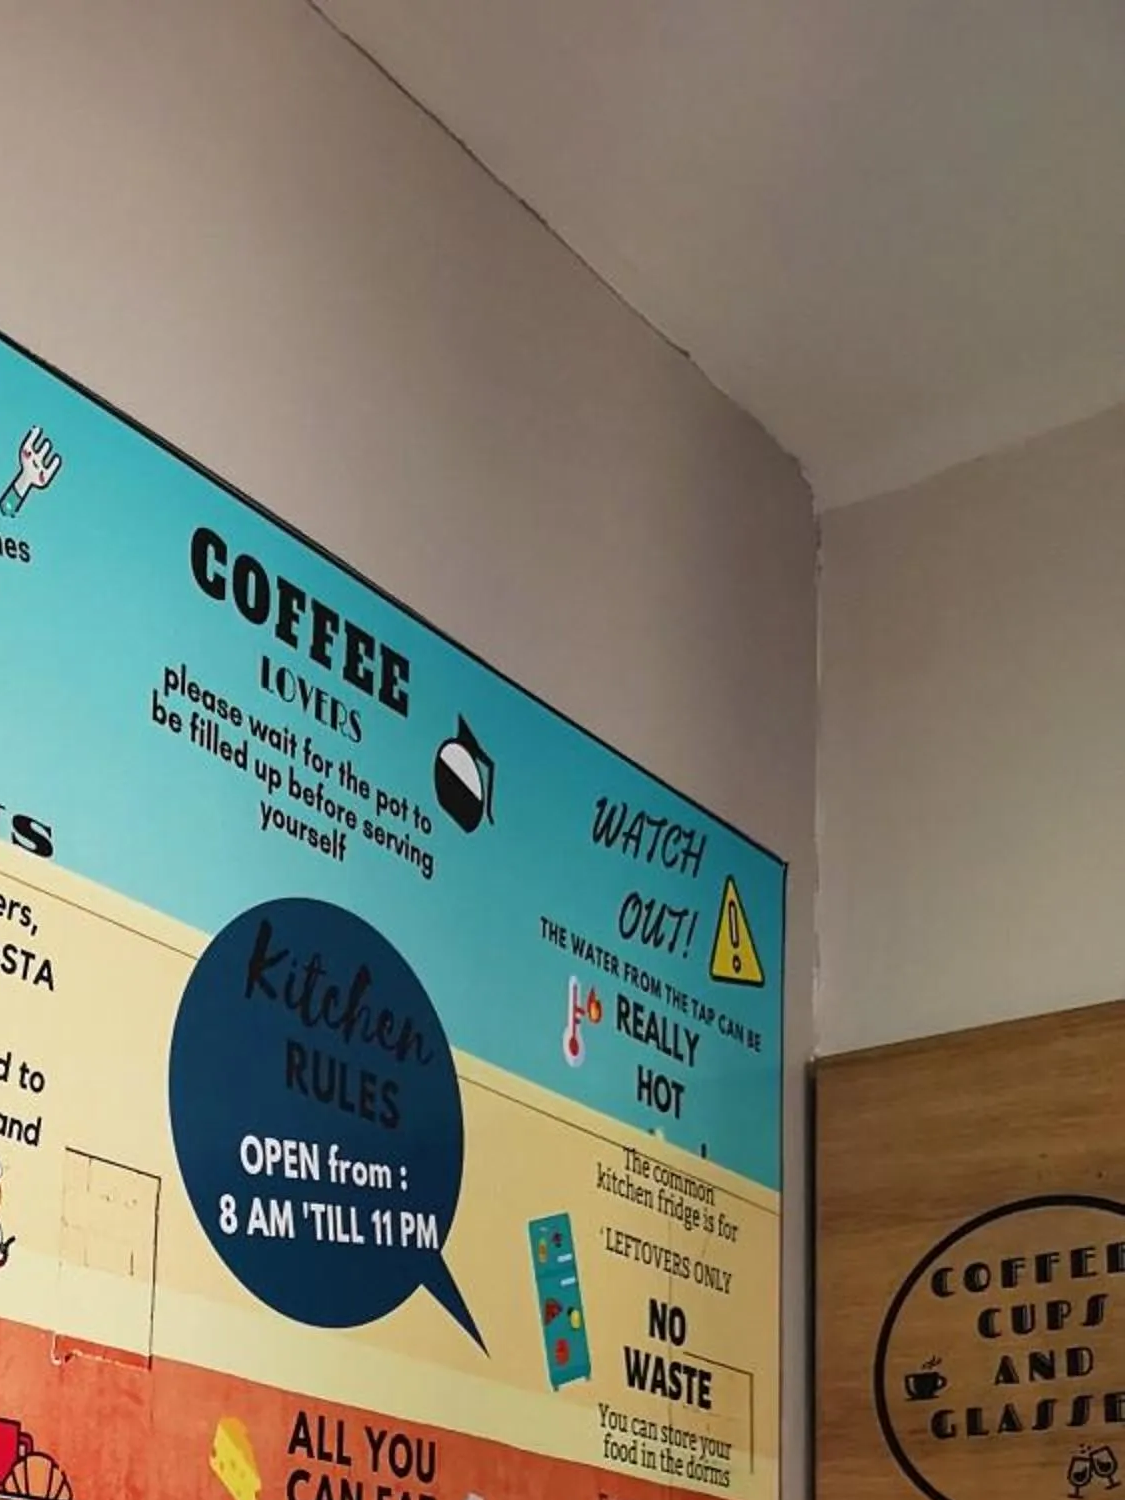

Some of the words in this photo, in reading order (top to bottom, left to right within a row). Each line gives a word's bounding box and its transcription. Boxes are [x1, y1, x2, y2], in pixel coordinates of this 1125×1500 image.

[190, 526, 410, 718] COFFEE
[260, 655, 362, 743] LOVERS
[164, 663, 242, 728] please
[249, 715, 297, 759] wait
[303, 737, 332, 773] for
[339, 760, 370, 799] the
[376, 787, 409, 823] pot
[414, 806, 432, 835] to
[152, 688, 182, 734] be
[190, 712, 248, 772] filled
[255, 758, 282, 794] up
[289, 766, 357, 829] before
[362, 817, 435, 880] serving
[260, 800, 347, 863] yourself
[592, 796, 707, 879] WATCH
[618, 891, 699, 959] OUT!
[244, 918, 435, 1066] Kitchen
[540, 916, 567, 950] THE
[572, 933, 620, 977] WATER
[624, 961, 662, 1000] FROM
[665, 983, 688, 1013] THE
[691, 997, 716, 1026] TAP
[718, 1014, 744, 1045] CAN
[746, 1030, 762, 1053] BE
[616, 994, 700, 1068] REALLY
[20, 1063, 45, 1094] to
[286, 1040, 401, 1130] RULES
[636, 1064, 686, 1120] HOT
[239, 1135, 320, 1181] OPEN
[328, 1145, 391, 1191] from
[623, 1146, 651, 1179] The
[652, 1164, 716, 1207] common
[219, 1193, 238, 1235] 8
[246, 1197, 296, 1239] AM
[303, 1200, 365, 1245] 'TILL
[371, 1210, 392, 1247] 11
[400, 1213, 439, 1250] PM
[596, 1162, 655, 1210] kitchen
[657, 1187, 700, 1232] fridge
[702, 1210, 715, 1235] is
[717, 1214, 739, 1244] for
[693, 1261, 733, 1296] ONLY
[648, 1298, 687, 1347] NO
[977, 1293, 1109, 1338] CUPS
[623, 1345, 713, 1411] WASTE
[994, 1346, 1094, 1385] AND
[287, 1411, 353, 1467] ALL
[363, 1425, 437, 1485] YOU
[598, 1402, 628, 1434] You
[630, 1414, 658, 1441] can
[660, 1421, 697, 1449] store
[699, 1435, 732, 1462] your
[603, 1433, 638, 1465] food
[640, 1443, 656, 1469] in
[659, 1448, 684, 1478] the
[686, 1458, 730, 1489] dorms
